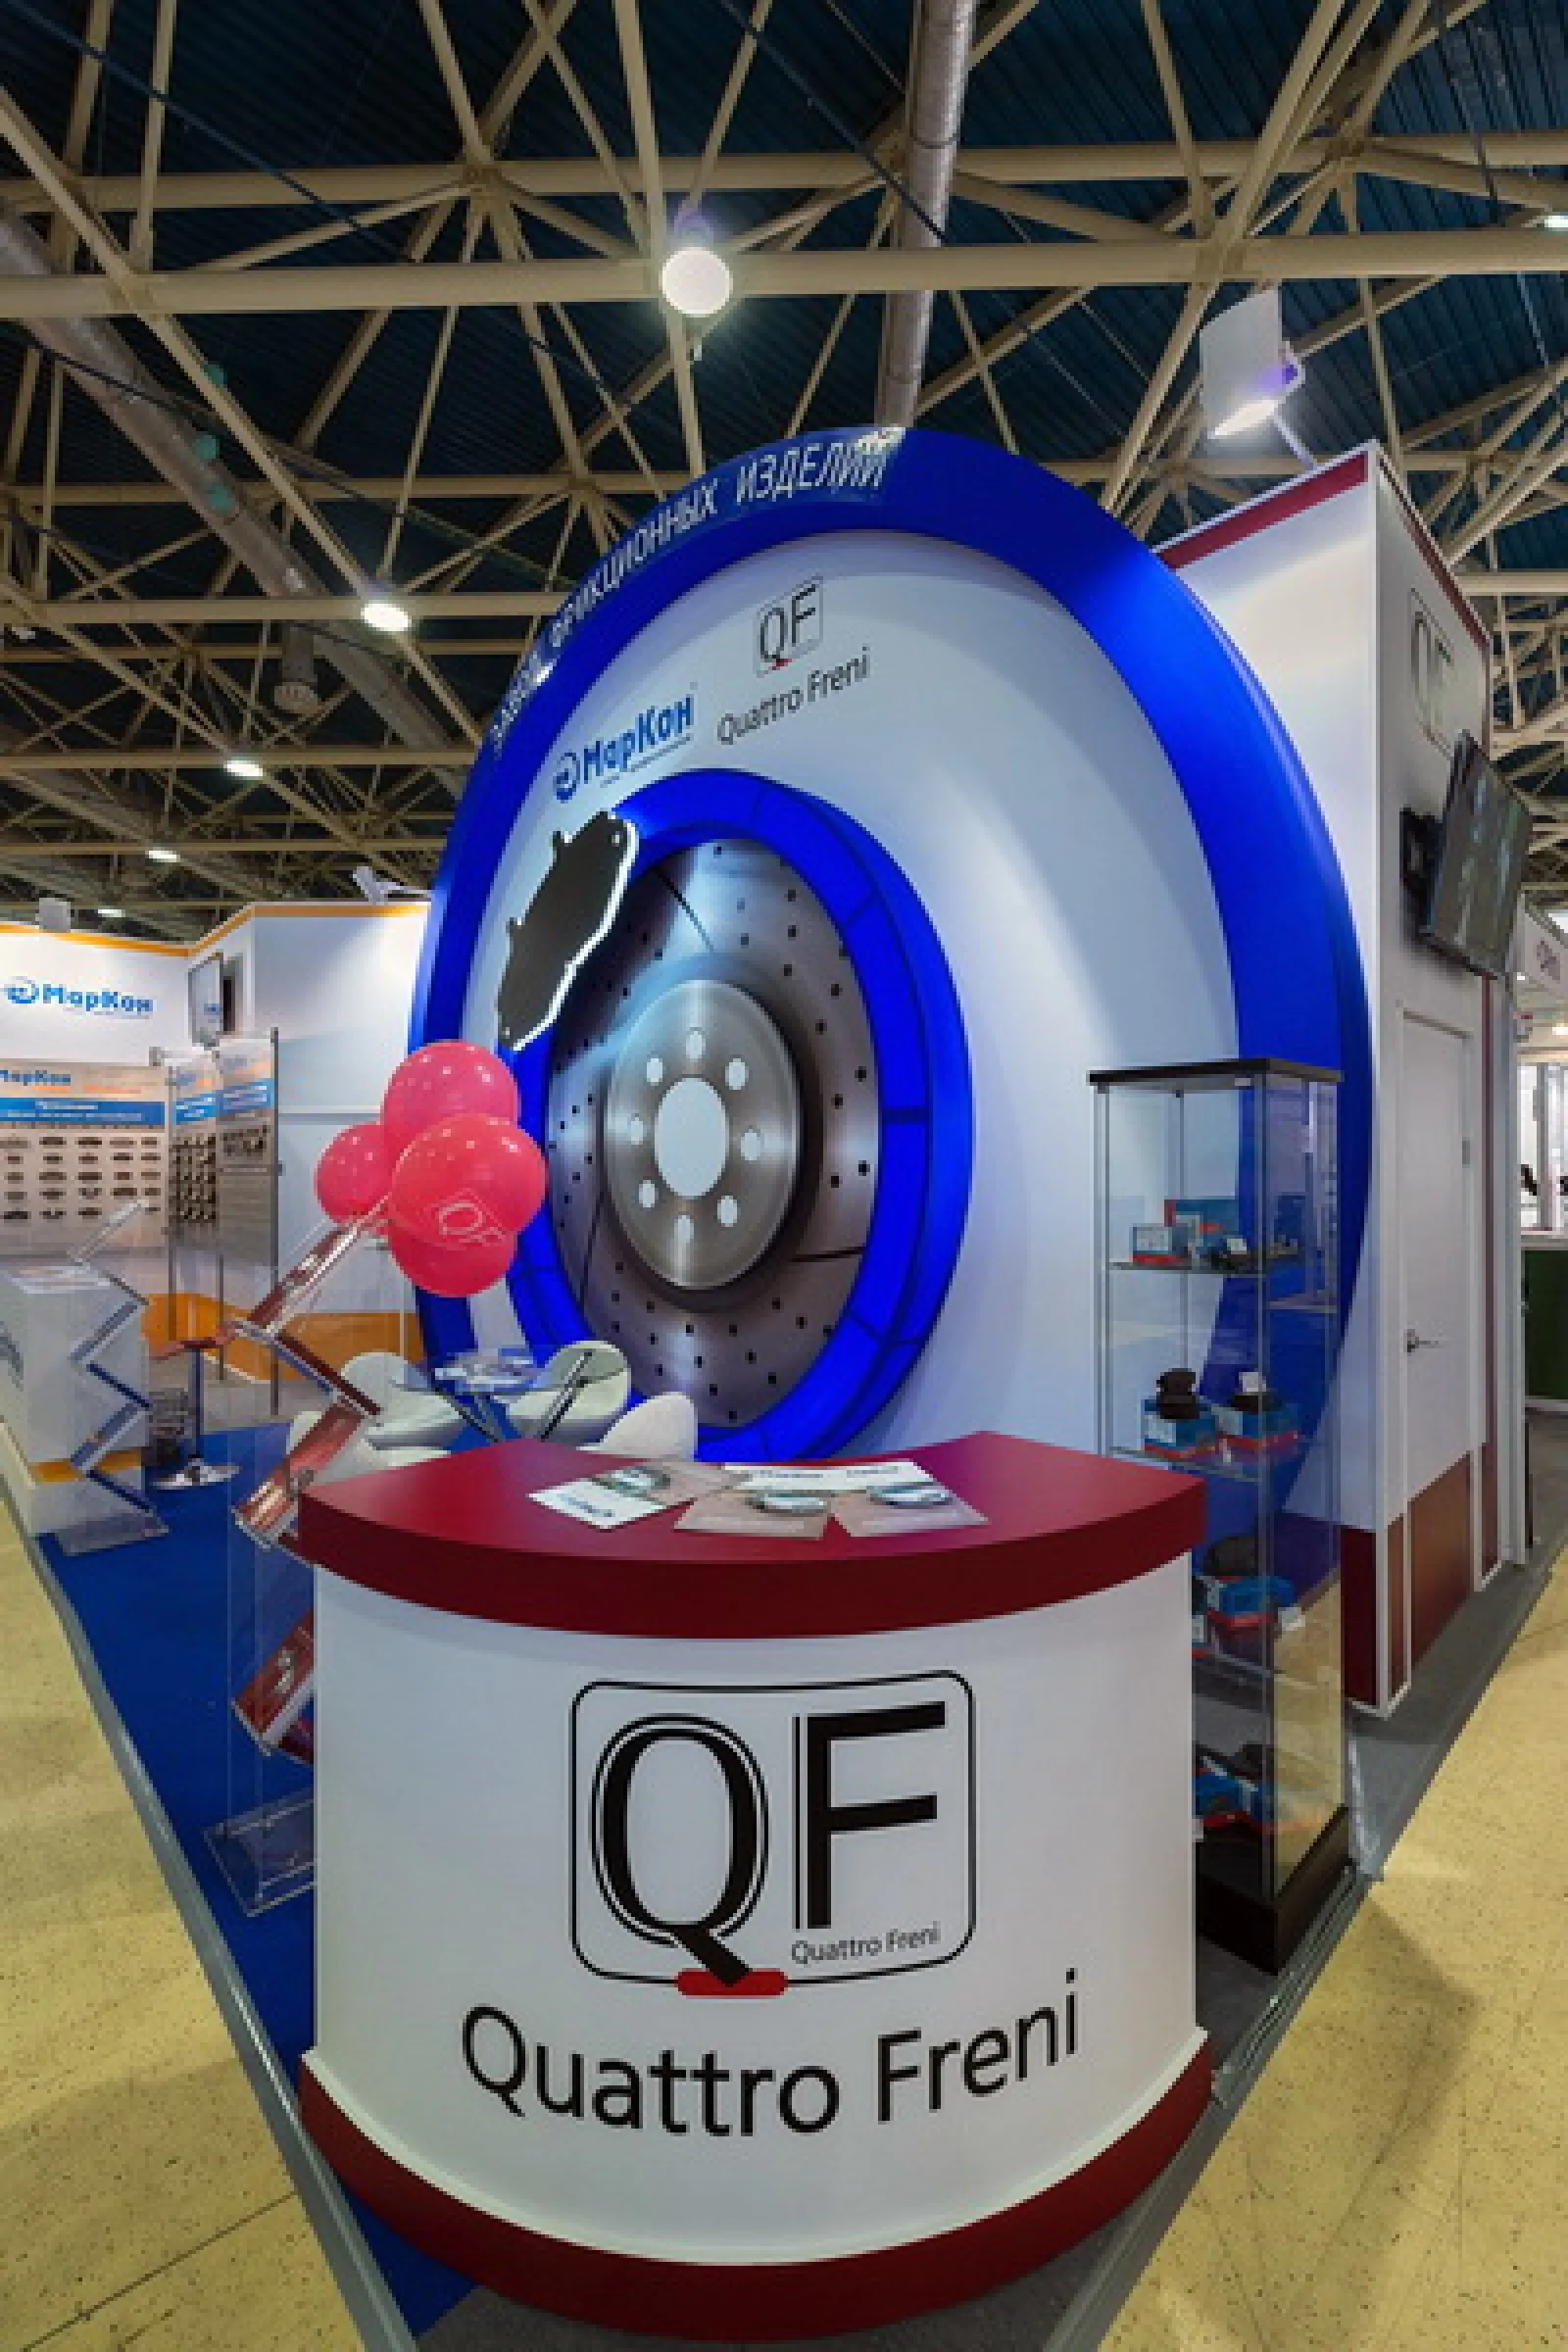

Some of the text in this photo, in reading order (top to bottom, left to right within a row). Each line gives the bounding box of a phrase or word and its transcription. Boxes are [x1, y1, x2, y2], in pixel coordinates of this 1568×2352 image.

[547, 478, 719, 649] ФРИКЦИОННЫХ
[759, 584, 817, 664] QF
[583, 696, 695, 781] МарКон
[716, 646, 871, 746] Quattro Freni
[42, 982, 154, 1013] МарКон
[590, 1699, 947, 1987] QF
[791, 1921, 942, 1966] Quattro Freni
[461, 1966, 1079, 2137] Quattro Freni
